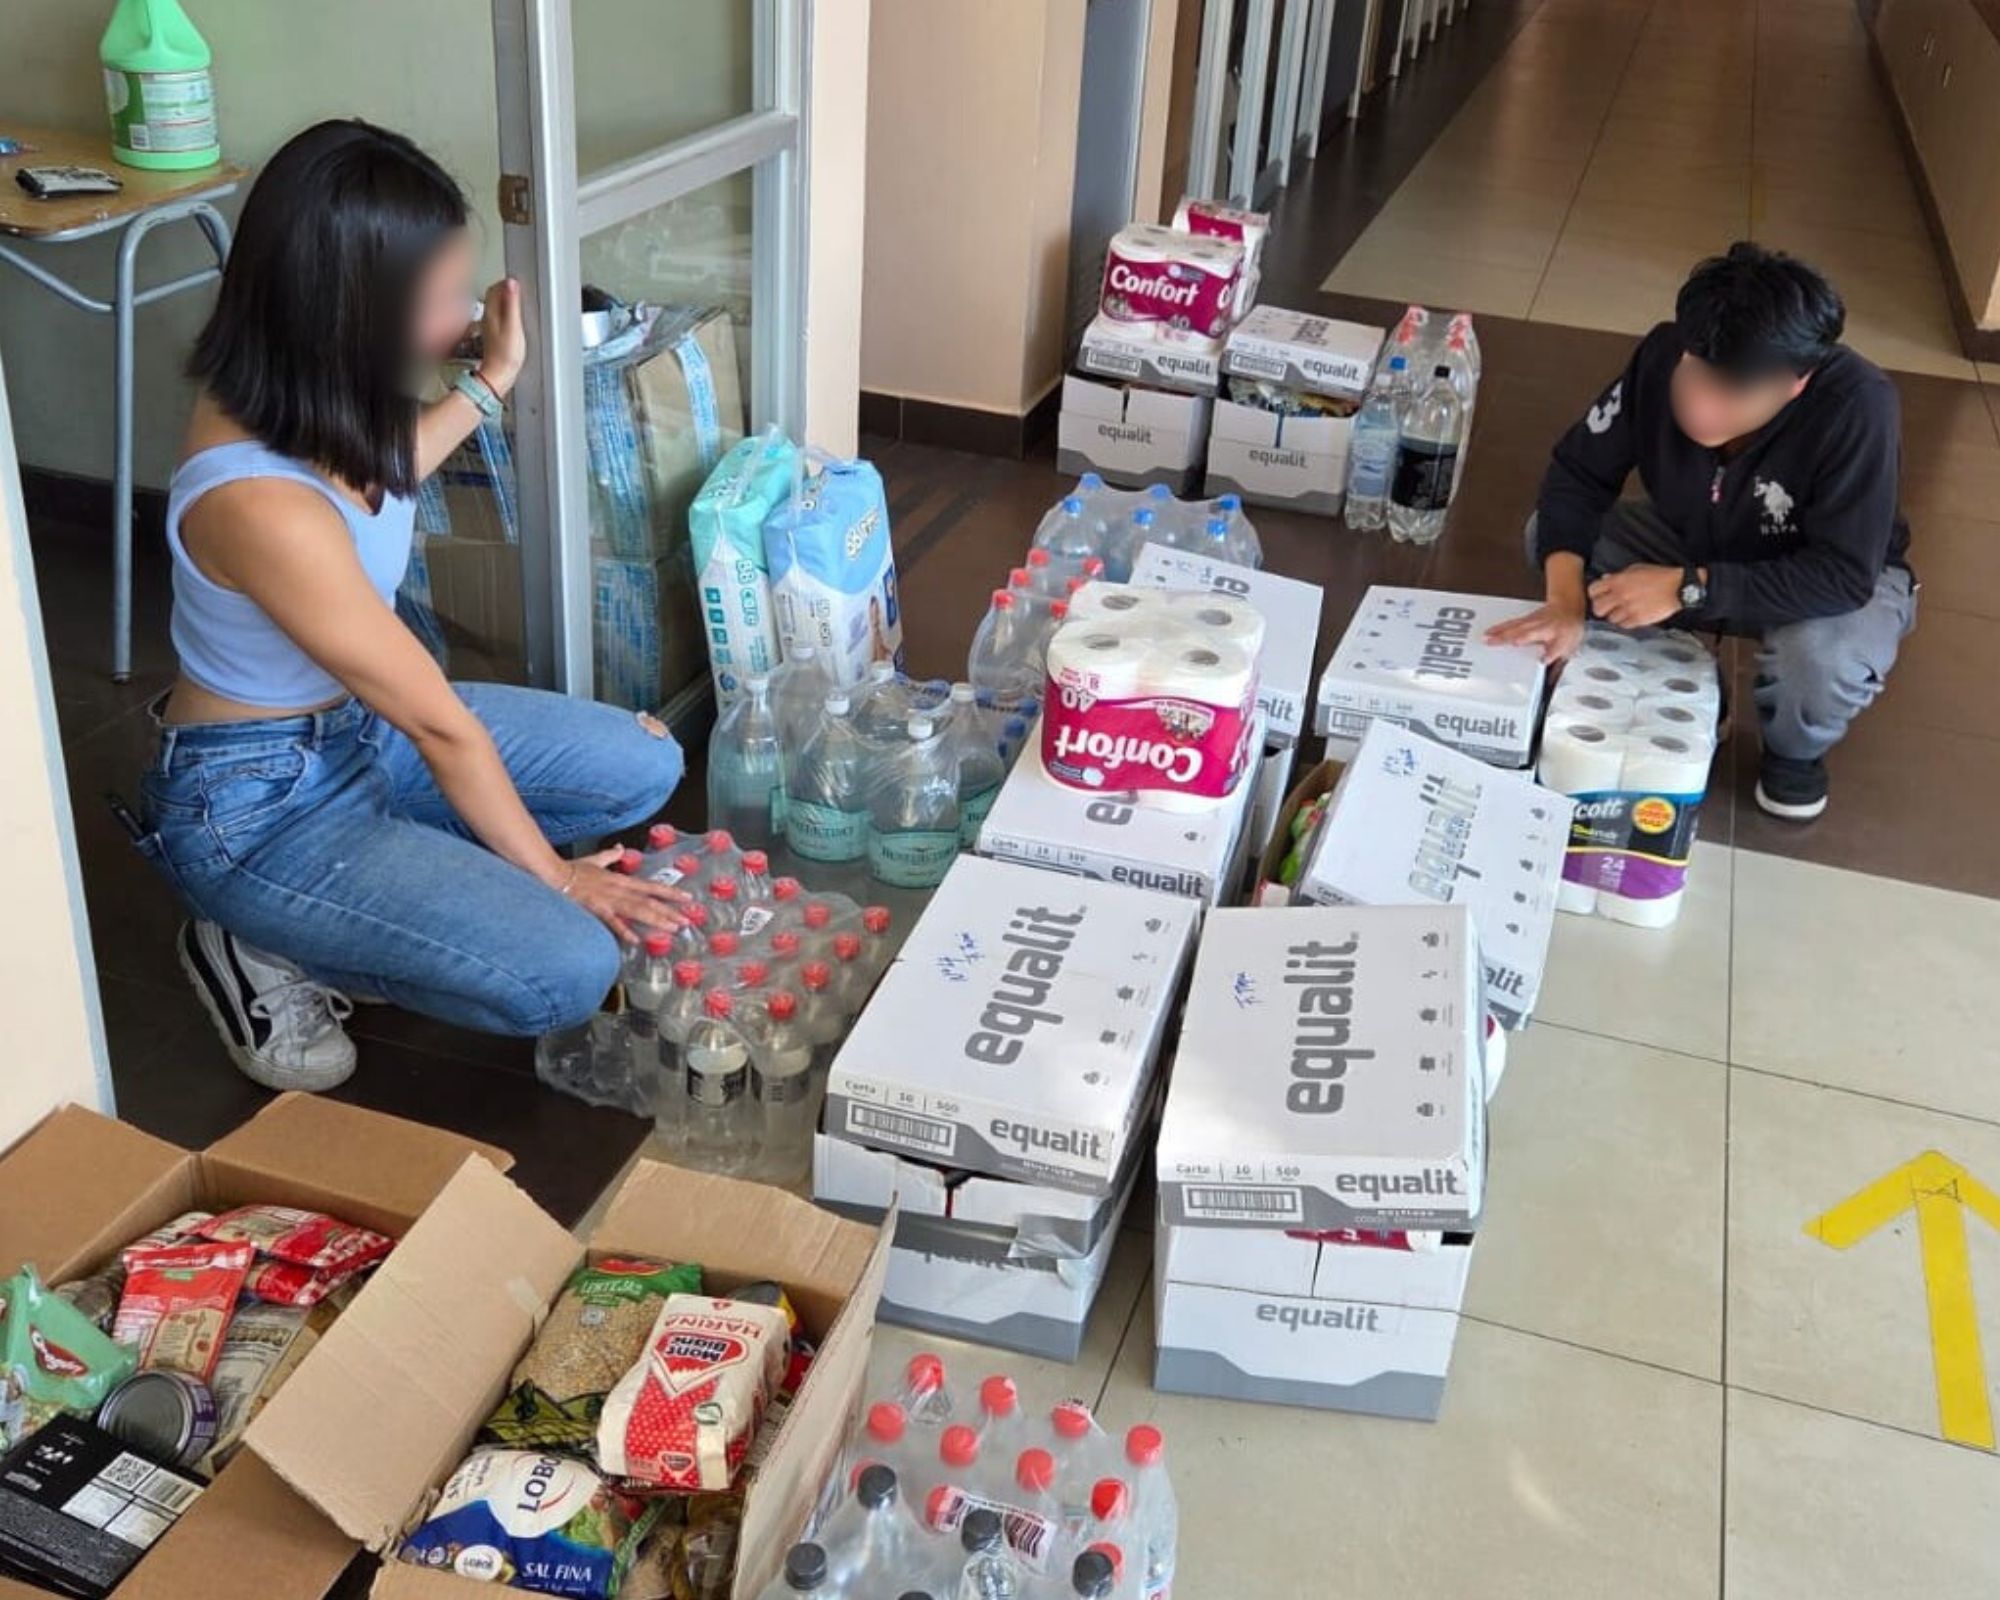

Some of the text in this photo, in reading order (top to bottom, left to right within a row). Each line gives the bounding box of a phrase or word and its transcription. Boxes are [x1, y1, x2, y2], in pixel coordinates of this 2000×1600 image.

[1110, 265, 1198, 306] Confort
[1158, 355, 1211, 377] equalit
[1302, 355, 1359, 383] equalit
[1098, 421, 1152, 445] equalit
[1249, 449, 1308, 470] equalit
[1415, 606, 1476, 679] equalit
[1062, 687, 1098, 713] 40
[1434, 712, 1518, 738] equalit
[1054, 725, 1203, 783] Confort
[1572, 799, 1624, 820] cott
[1601, 857, 1625, 871] 24
[1111, 864, 1204, 898] equalit
[964, 905, 1084, 1066] equalit
[1485, 966, 1525, 1001] alit
[1283, 939, 1376, 1115] equalit
[990, 1118, 1101, 1160] equalit
[1336, 1168, 1460, 1201] equalit
[1256, 1303, 1380, 1333] equalit
[665, 1346, 722, 1362] Mont
[523, 1562, 592, 1582] SAL FINA
